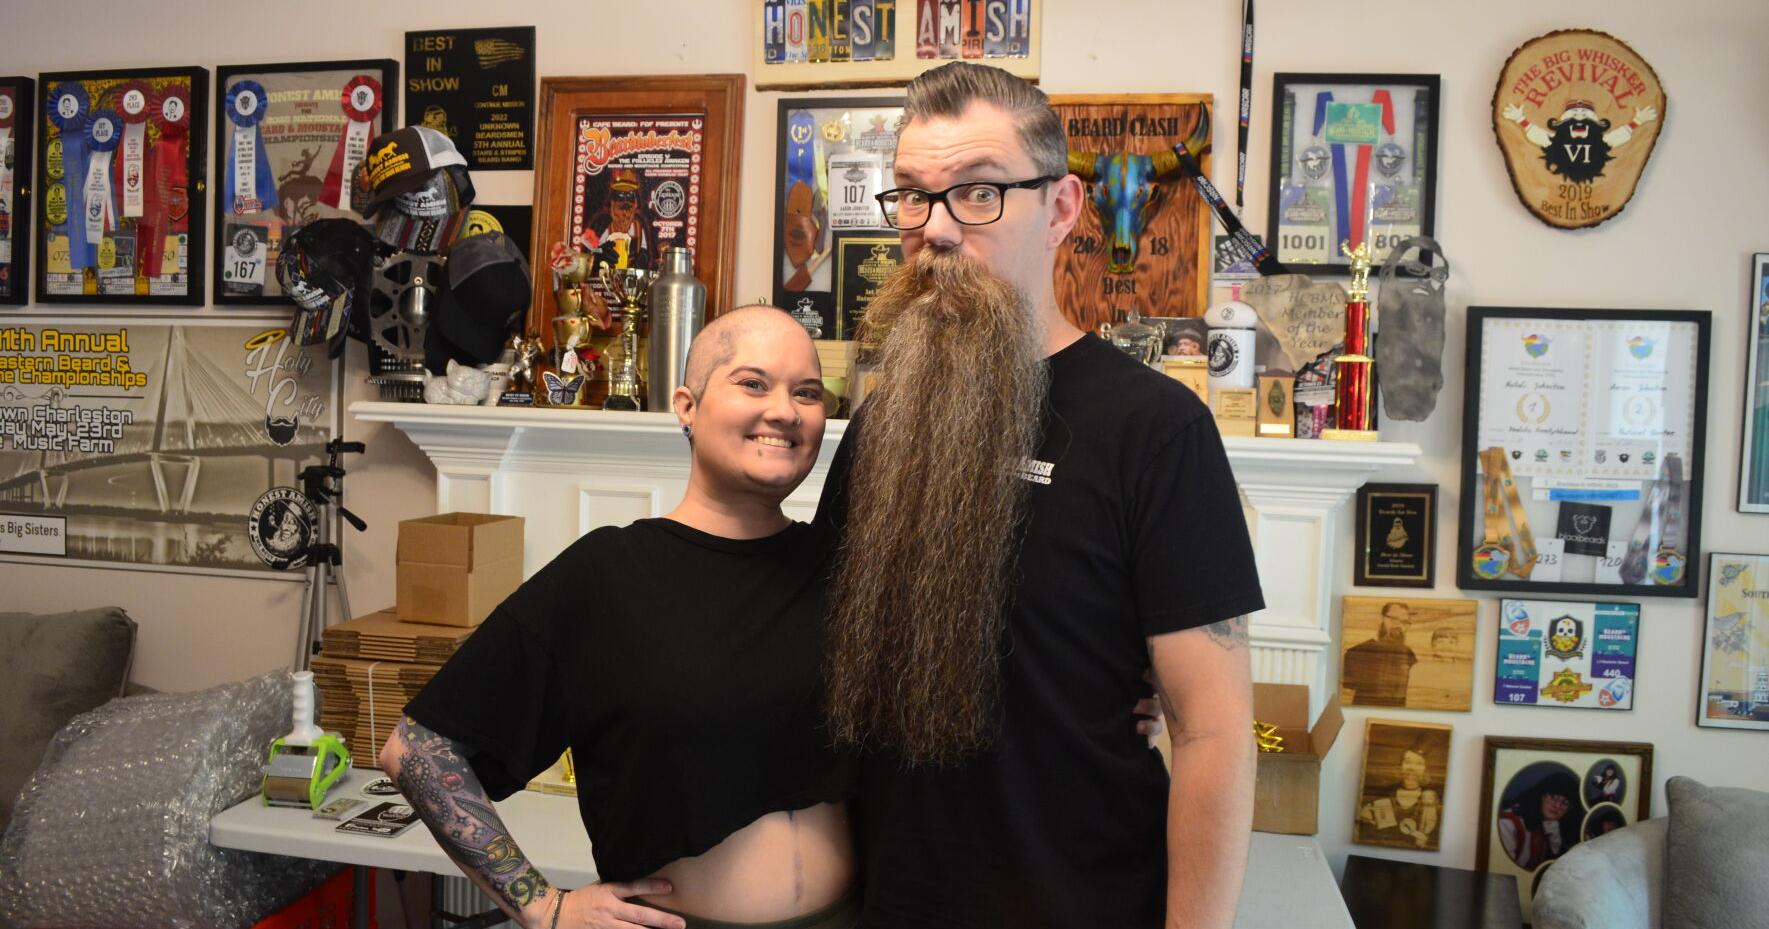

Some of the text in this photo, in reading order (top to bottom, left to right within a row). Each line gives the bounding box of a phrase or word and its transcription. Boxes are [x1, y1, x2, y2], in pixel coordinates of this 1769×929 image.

[765, 0, 1028, 46] HONEST AMISH
[412, 36, 455, 51] BEST
[426, 57, 442, 71] IN
[1512, 48, 1648, 97] THE BIG WHISKER
[409, 78, 459, 92] SHOW
[491, 84, 508, 97] CM
[1525, 63, 1635, 110] REVIVAL
[267, 89, 311, 103] ONEST
[262, 124, 286, 135] ARD
[296, 122, 341, 133] MOUSTA
[480, 122, 519, 130] UNKNOWN
[1068, 117, 1179, 137] BEARD CLASH
[263, 134, 342, 145] HAMPIONSHI
[475, 131, 524, 139] BEARDSMEN
[474, 140, 526, 149] 5TH ANNUAL
[1564, 144, 1591, 164] VI
[844, 185, 866, 204] 107
[1558, 184, 1593, 201] 2019
[1541, 200, 1610, 220] Best In Show
[1073, 236, 1169, 255] 20 18
[1282, 234, 1325, 251] 1001
[234, 260, 256, 279] 167
[1103, 277, 1137, 295] Best
[1282, 306, 1344, 320] Member
[1287, 320, 1331, 336] of the
[41, 328, 129, 352] Annual
[1290, 336, 1328, 349] Year
[58, 354, 111, 371] Beard
[116, 355, 131, 371] &
[246, 335, 312, 395] Holy
[19, 367, 147, 390] Championships
[266, 378, 323, 420] City
[0, 404, 132, 424] wn Charleston
[76, 420, 124, 439] 23rd
[13, 432, 114, 452] Music Farm
[1020, 472, 1052, 485] BEARD
[252, 489, 288, 520] HONEST
[7, 521, 23, 538] Big
[25, 522, 59, 537] Sisters
[1508, 693, 1526, 702] 107
